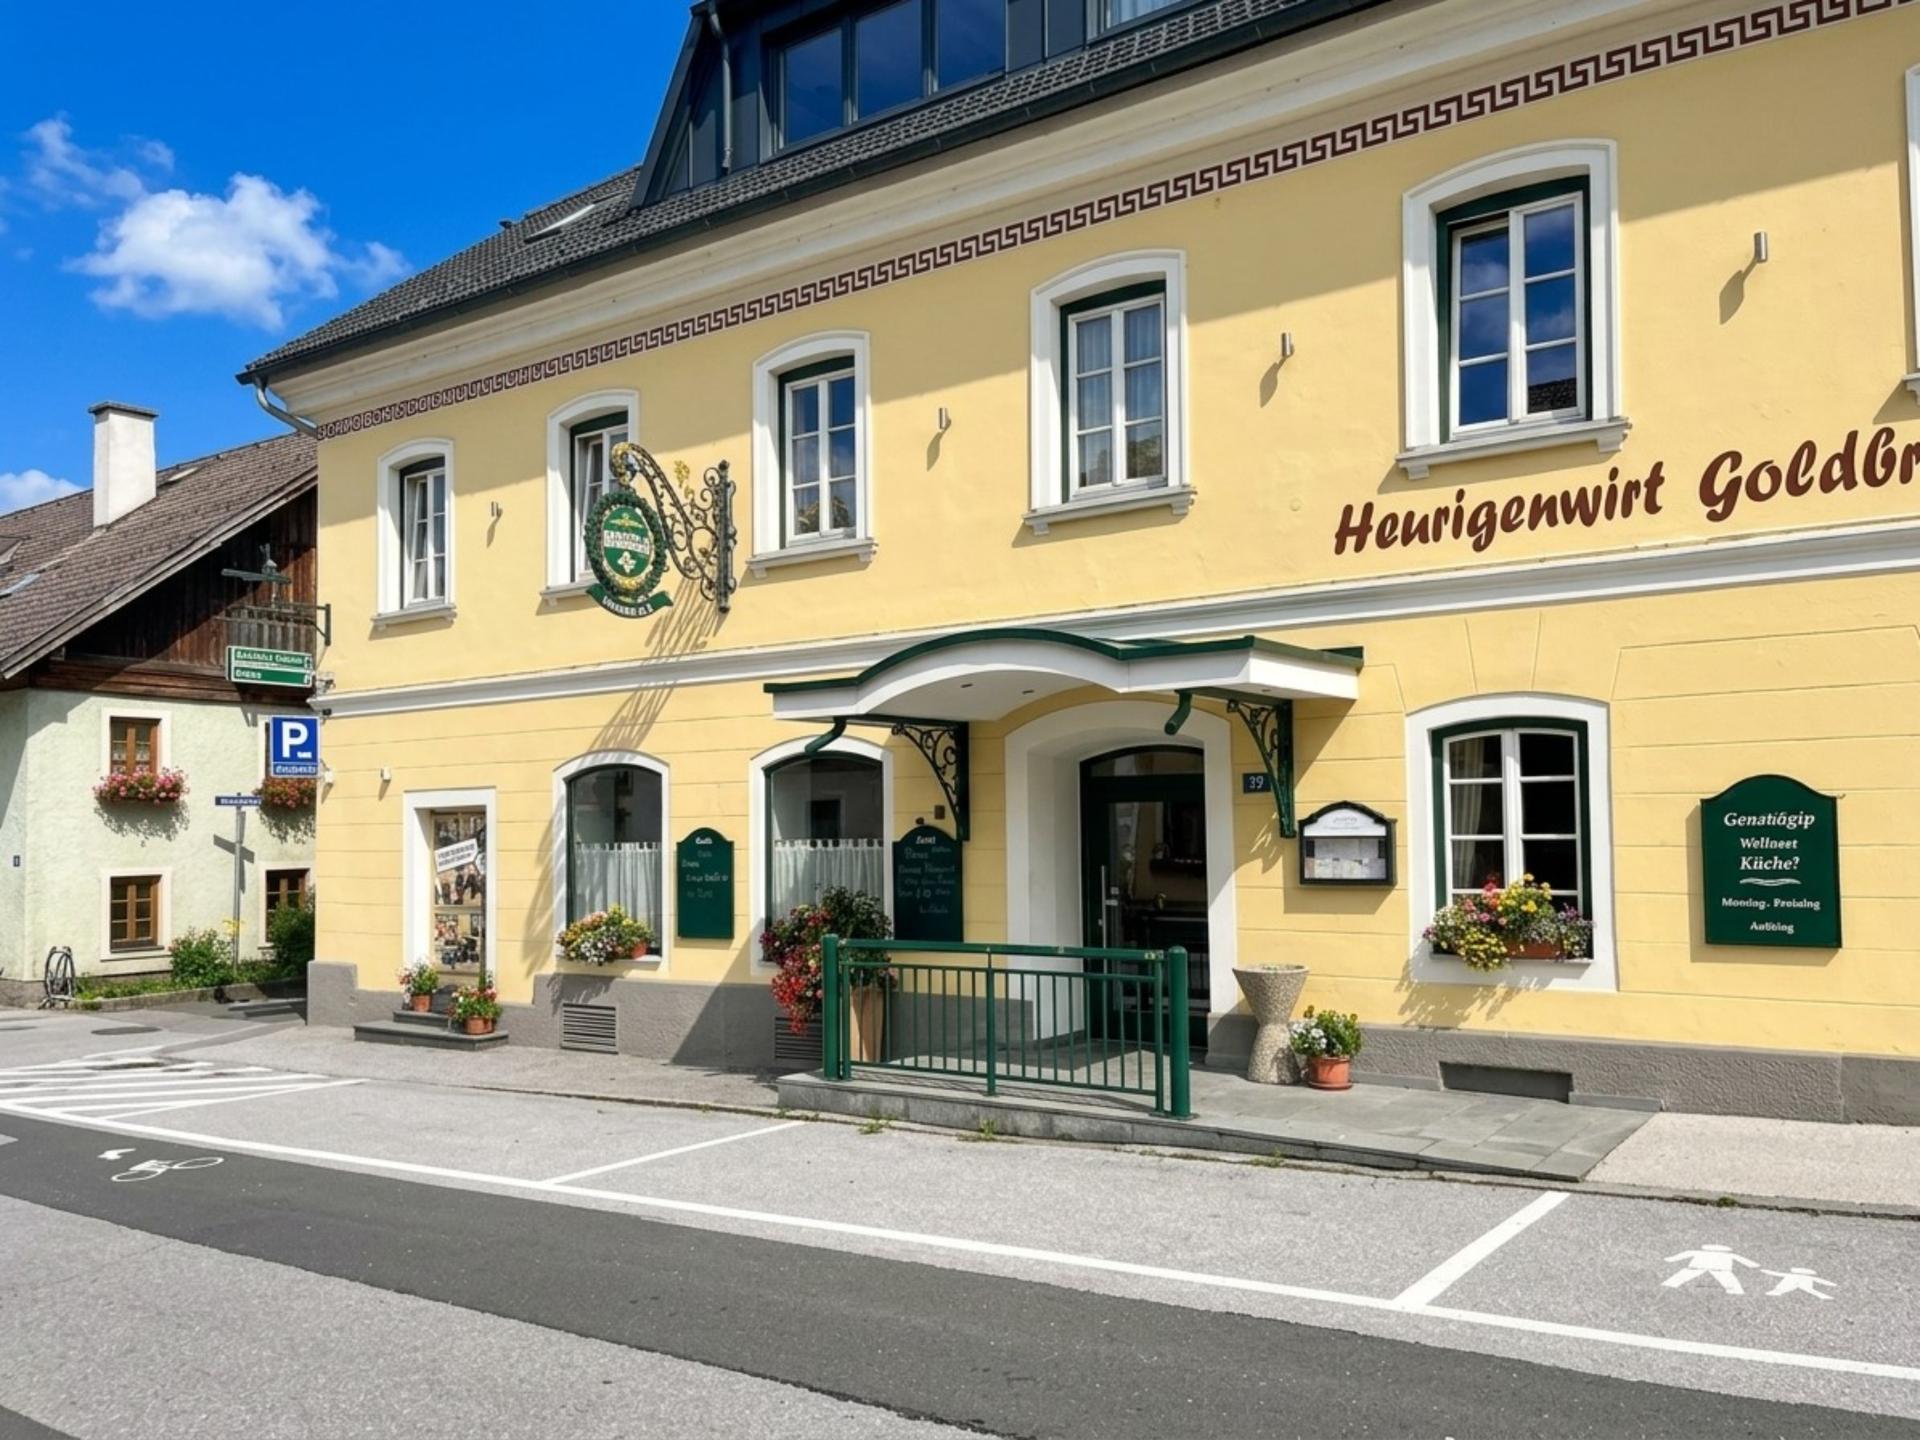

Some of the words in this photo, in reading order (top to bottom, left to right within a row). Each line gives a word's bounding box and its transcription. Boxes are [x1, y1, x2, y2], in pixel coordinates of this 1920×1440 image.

[1334, 460, 1664, 555] Heurigenwirt
[281, 721, 309, 759] P
[1249, 776, 1264, 789] 39
[1739, 856, 1800, 870] Küche?
